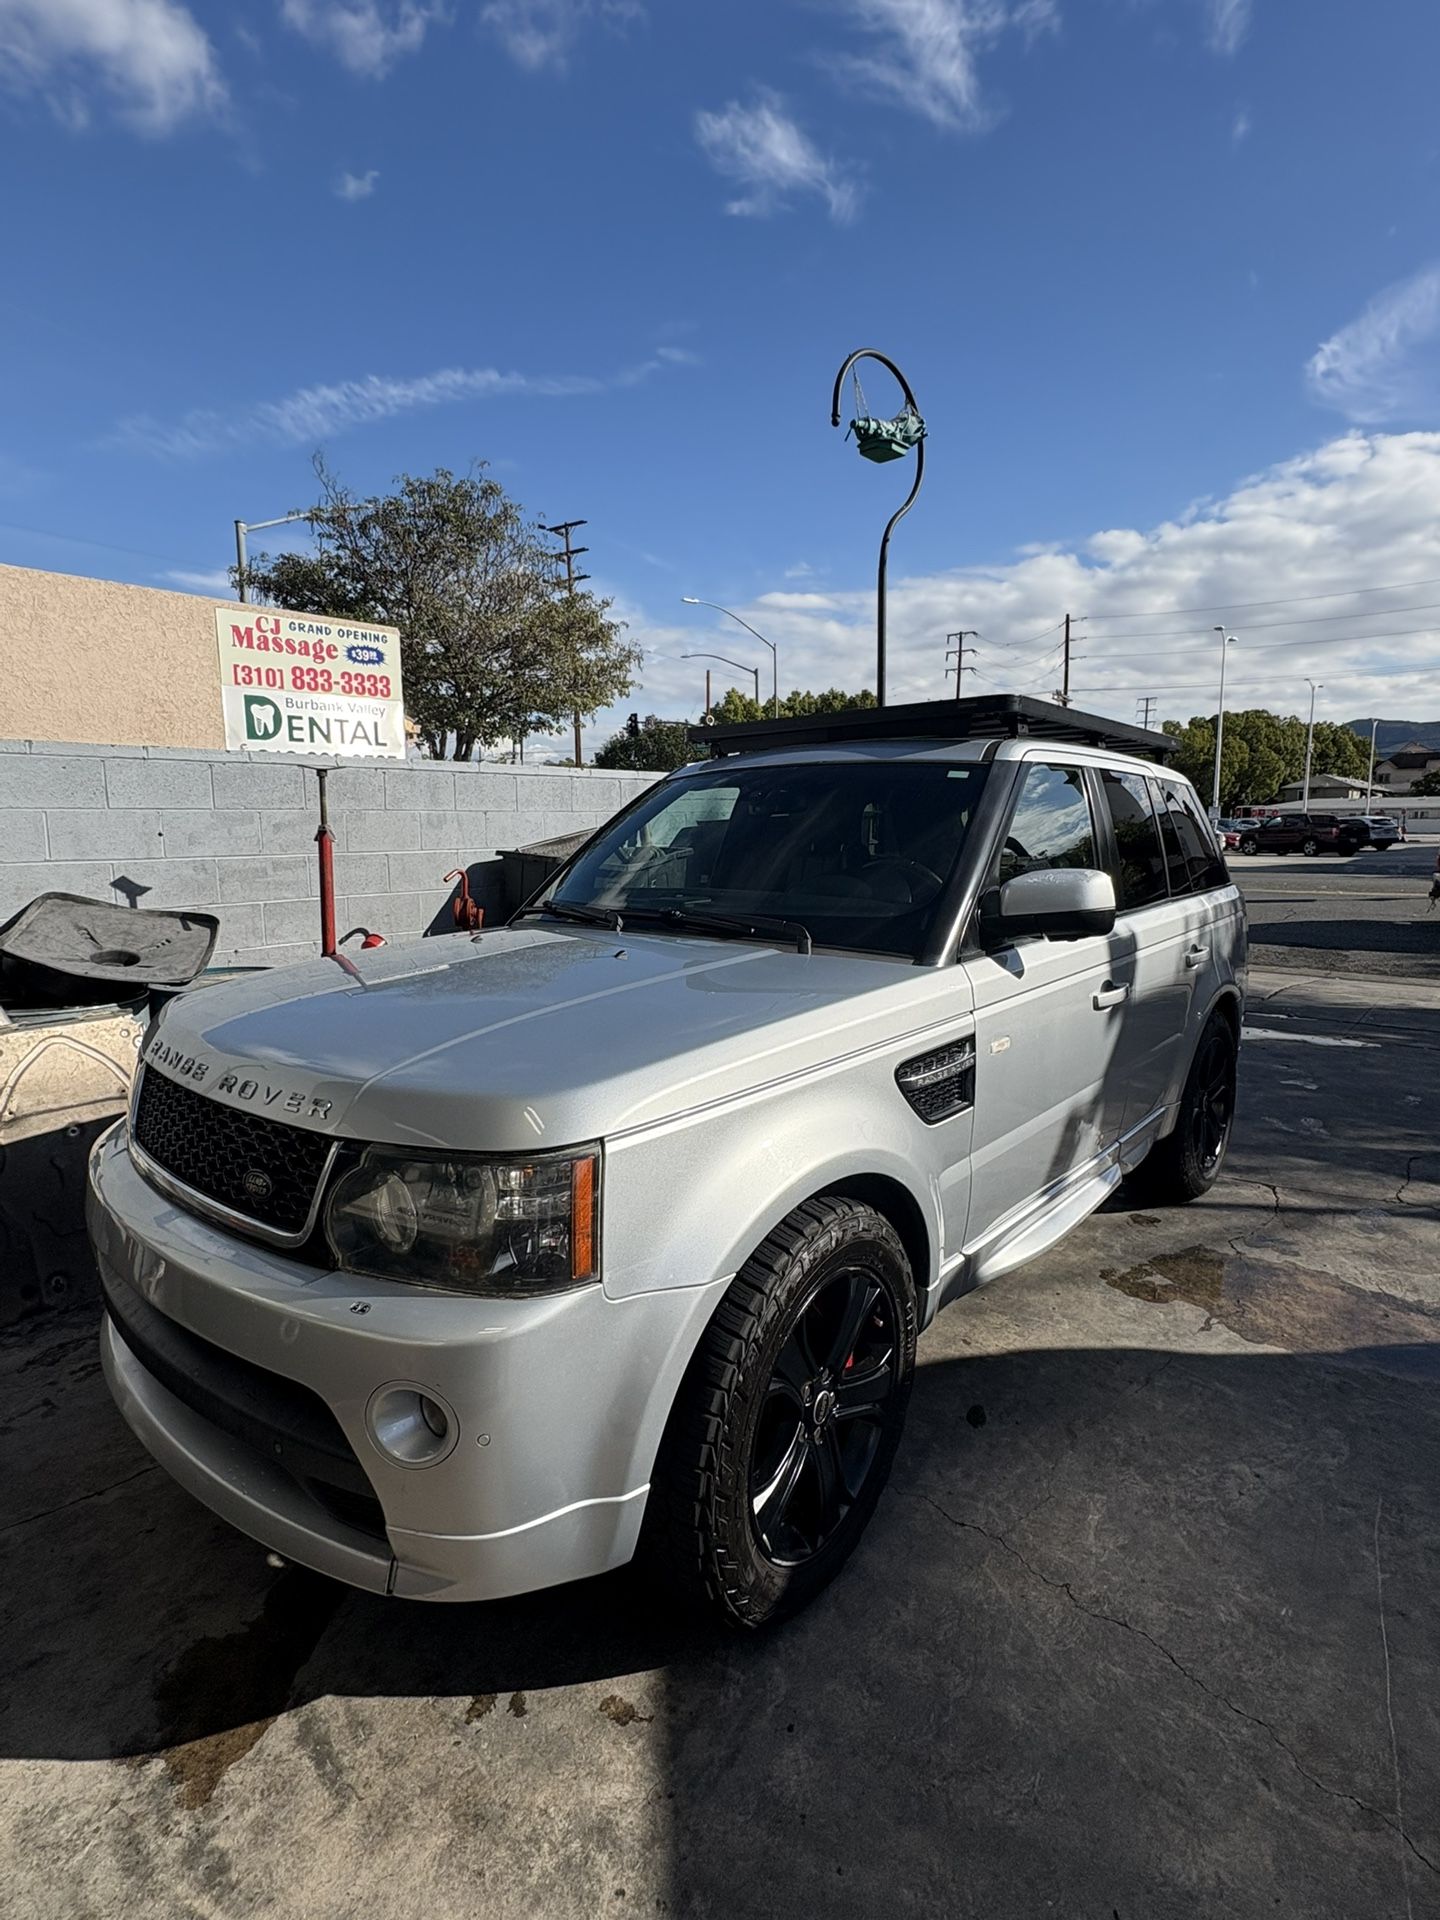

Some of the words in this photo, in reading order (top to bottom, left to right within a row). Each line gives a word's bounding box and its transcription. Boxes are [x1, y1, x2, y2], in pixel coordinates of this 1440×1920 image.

[255, 616, 281, 635] CJ
[288, 621, 332, 636] GRAND
[337, 629, 388, 644] OPENING
[230, 624, 339, 664] Massage
[232, 664, 285, 690] [310]
[291, 665, 391, 698] 833-3333
[244, 694, 388, 747] DENTAL
[285, 697, 343, 712] Burbank
[348, 702, 386, 718] Valley
[152, 1039, 209, 1082] RANGE
[219, 1074, 333, 1120] ROVER
